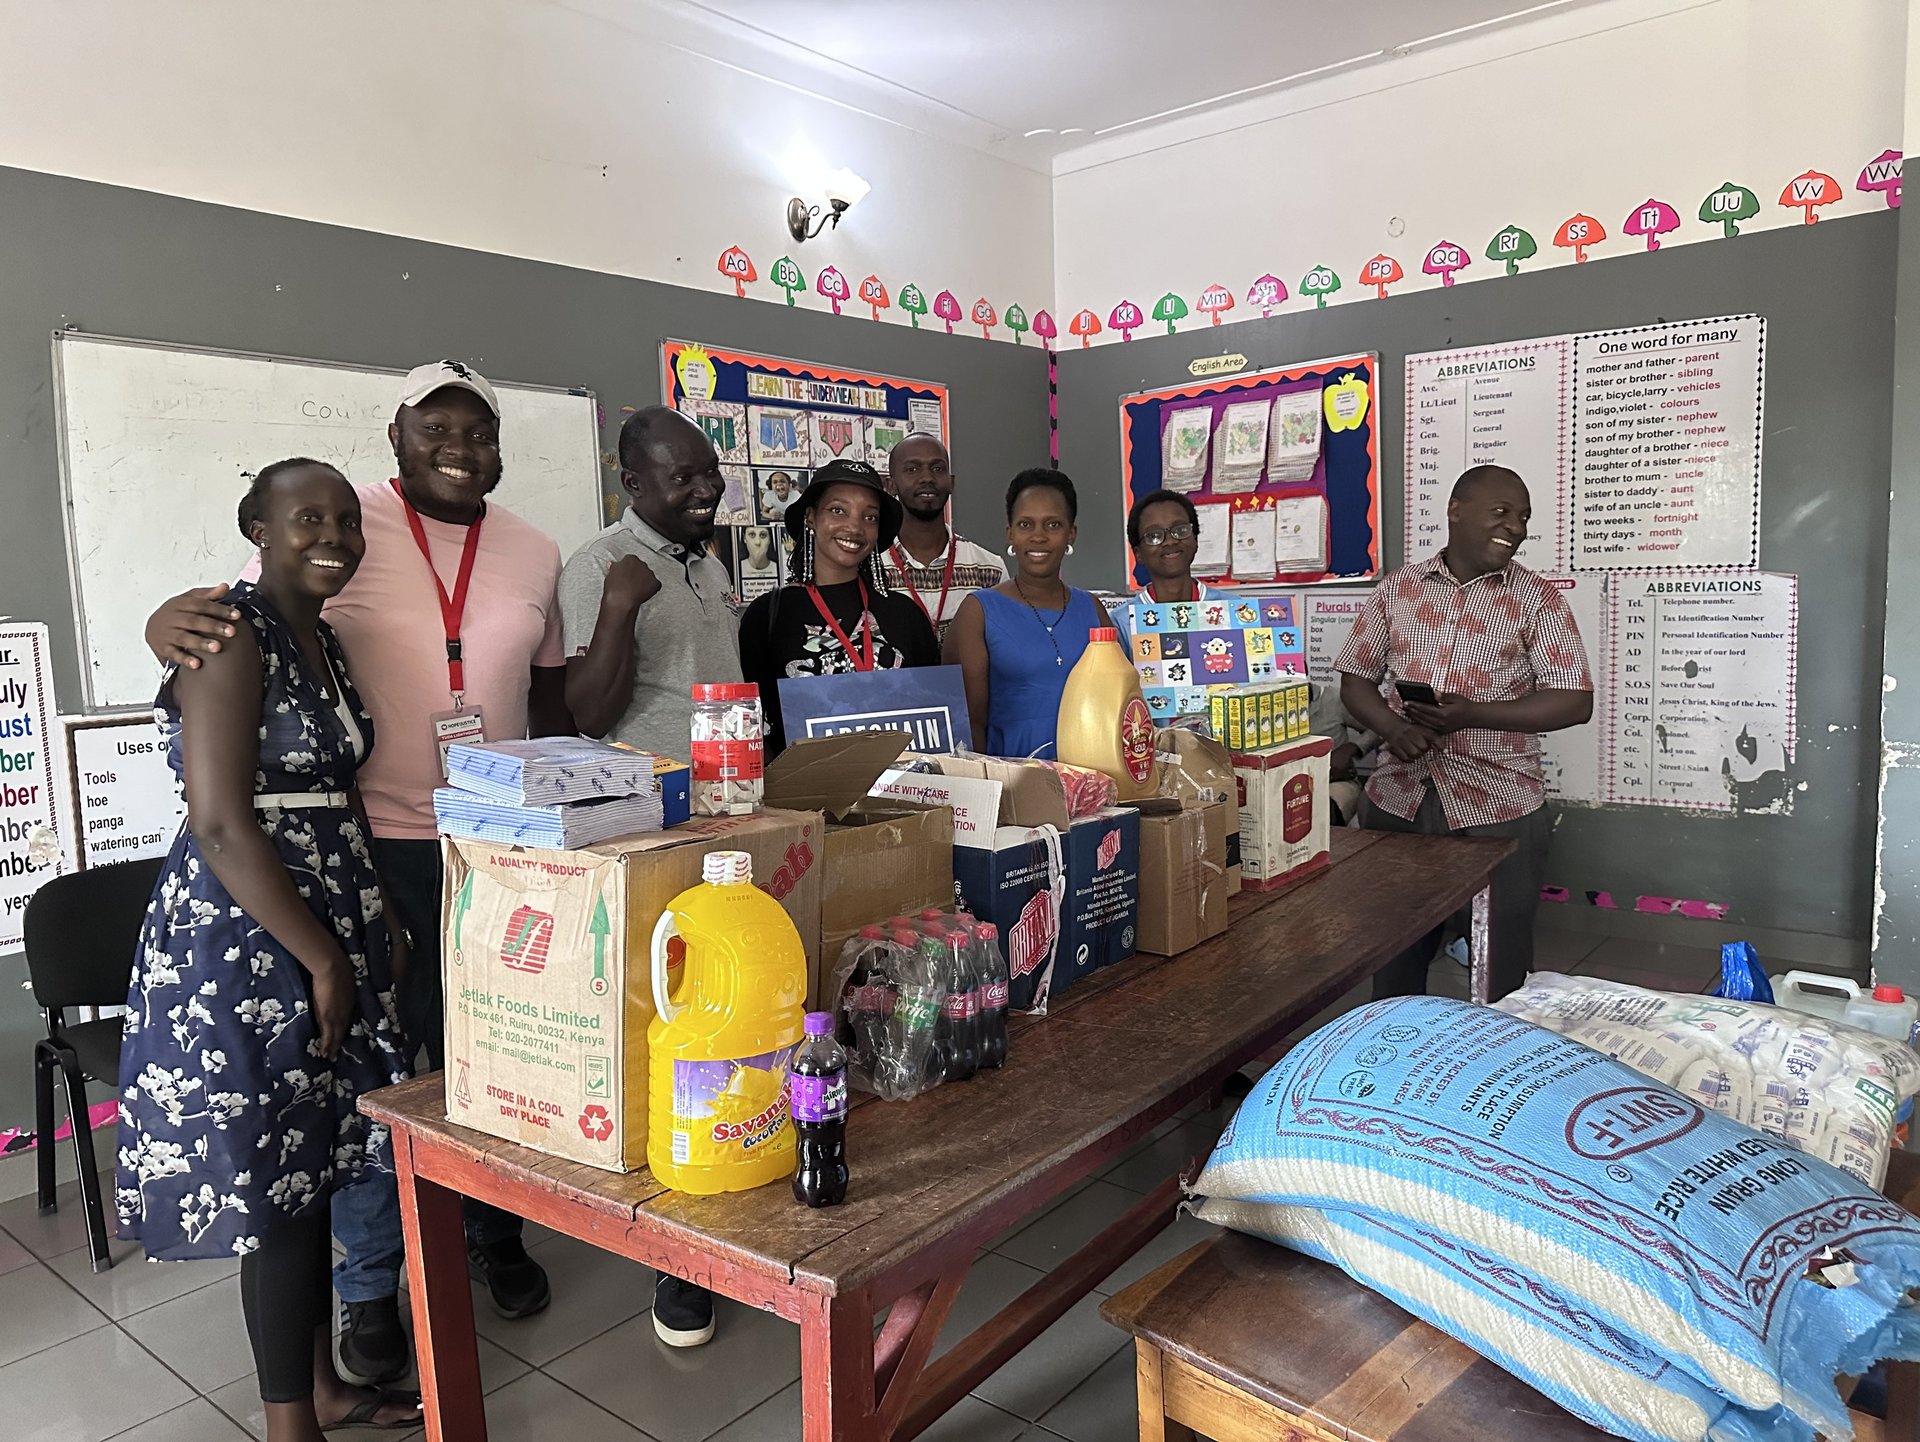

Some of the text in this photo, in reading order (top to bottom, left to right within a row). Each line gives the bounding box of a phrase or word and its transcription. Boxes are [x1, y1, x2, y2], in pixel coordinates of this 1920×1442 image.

[1794, 181, 1823, 199] Vv
[1713, 194, 1741, 212] Uu
[1642, 209, 1659, 228] Tt
[1569, 224, 1587, 240] Ss
[1501, 233, 1518, 251] Rr
[1432, 247, 1460, 266] Qq
[726, 256, 747, 272] Aa
[780, 265, 797, 284] Bb
[1371, 262, 1392, 281] Pp
[823, 274, 841, 293] Cc
[1306, 272, 1331, 288] Oo
[865, 281, 882, 299] Dd
[905, 286, 919, 305] Ee
[1201, 292, 1228, 307] Mm
[976, 305, 992, 322] Gg
[1118, 307, 1133, 322] Kk
[1599, 328, 1738, 354] One word for many
[1192, 357, 1244, 372] English Area
[1437, 356, 1536, 378] ABBREVIATIONS
[1586, 352, 1720, 374] mother and father parent
[1473, 376, 1501, 385] Avenue
[1586, 366, 1714, 388] sister or brother sibling
[749, 373, 783, 397] LEARN
[785, 379, 803, 399] THE
[864, 390, 885, 409] RULE
[1473, 391, 1513, 401] Lieutenant
[1586, 393, 1604, 402] car,
[1677, 381, 1721, 393] vehicles
[1660, 398, 1700, 409] colours
[1473, 408, 1505, 417] Sergeant
[1420, 415, 1436, 425] Sgt.
[1420, 431, 1439, 439] Gen.
[1473, 424, 1502, 433] General
[1420, 446, 1440, 455] Brig.
[1473, 440, 1507, 449] Brigadier
[1585, 446, 1629, 458] daughter
[1631, 445, 1642, 454] of
[1653, 442, 1691, 453] brother
[1700, 439, 1730, 449] niece
[1420, 462, 1439, 471] Maj.
[1473, 456, 1496, 465] Major
[1420, 478, 1439, 486] Hon.
[1419, 493, 1432, 501] Dr.
[1419, 508, 1430, 516] Tr.
[1584, 512, 1699, 526] two weeks fortnight
[1419, 523, 1441, 533] Capt.
[1583, 527, 1682, 541] thirty days month
[1419, 539, 1432, 547] HE
[1583, 542, 1680, 553] lost wife widower
[1646, 580, 1762, 593] ABBREVIATIONS
[1316, 602, 1351, 612] Plurals
[1626, 598, 1700, 608] Tel. Telephone
[1310, 615, 1336, 624] Singular
[1626, 616, 1646, 624] TIN
[1678, 614, 1730, 622] Identification
[1732, 614, 1765, 622] Number
[1626, 631, 1645, 640] PIN
[1696, 631, 1748, 639] Identification
[1626, 648, 1641, 656] AD
[1310, 666, 1334, 674] mango
[1626, 664, 1640, 673] BC
[1625, 680, 1651, 689] S.O.S
[1625, 697, 1649, 705] INRI
[1624, 713, 1651, 723] Corp.
[1624, 729, 1643, 737] Col.
[117, 741, 153, 755] Uses
[1134, 743, 1146, 753] GOLD
[84, 771, 116, 785] Tools
[1623, 777, 1643, 786] Cpl.
[0, 783, 38, 807] ber
[902, 785, 924, 796] WITH
[926, 788, 949, 799] CARE
[87, 795, 108, 808] hoe
[89, 816, 124, 833] panga
[91, 833, 161, 852] watering can
[490, 855, 588, 877] A QUALITY PRODUCT
[1005, 866, 1028, 879] BRITANIA
[1012, 897, 1056, 973] BRITANI
[595, 981, 603, 991] 5
[459, 985, 600, 1030] Jetlak Foods Limited
[472, 1007, 488, 1021] Box
[489, 1013, 506, 1027] 461,
[509, 1017, 536, 1034] Ruiru,
[537, 1024, 568, 1041] 00232,
[570, 1029, 605, 1048] Kenya
[488, 1026, 560, 1054] Tel: 020-2077411
[475, 1038, 576, 1074] email: mail@jetlak.com
[486, 1084, 565, 1118] STORE IN A COOL
[1477, 1088, 1509, 1121] PLACE
[1489, 1075, 1554, 1140] CONSUMPTION
[500, 1105, 551, 1129] DRY PLACE
[1586, 1094, 1687, 1149] SWT-F
[1654, 1148, 1748, 1222] WHITE RICE
[1708, 1157, 1810, 1217] LONG GRAIN
